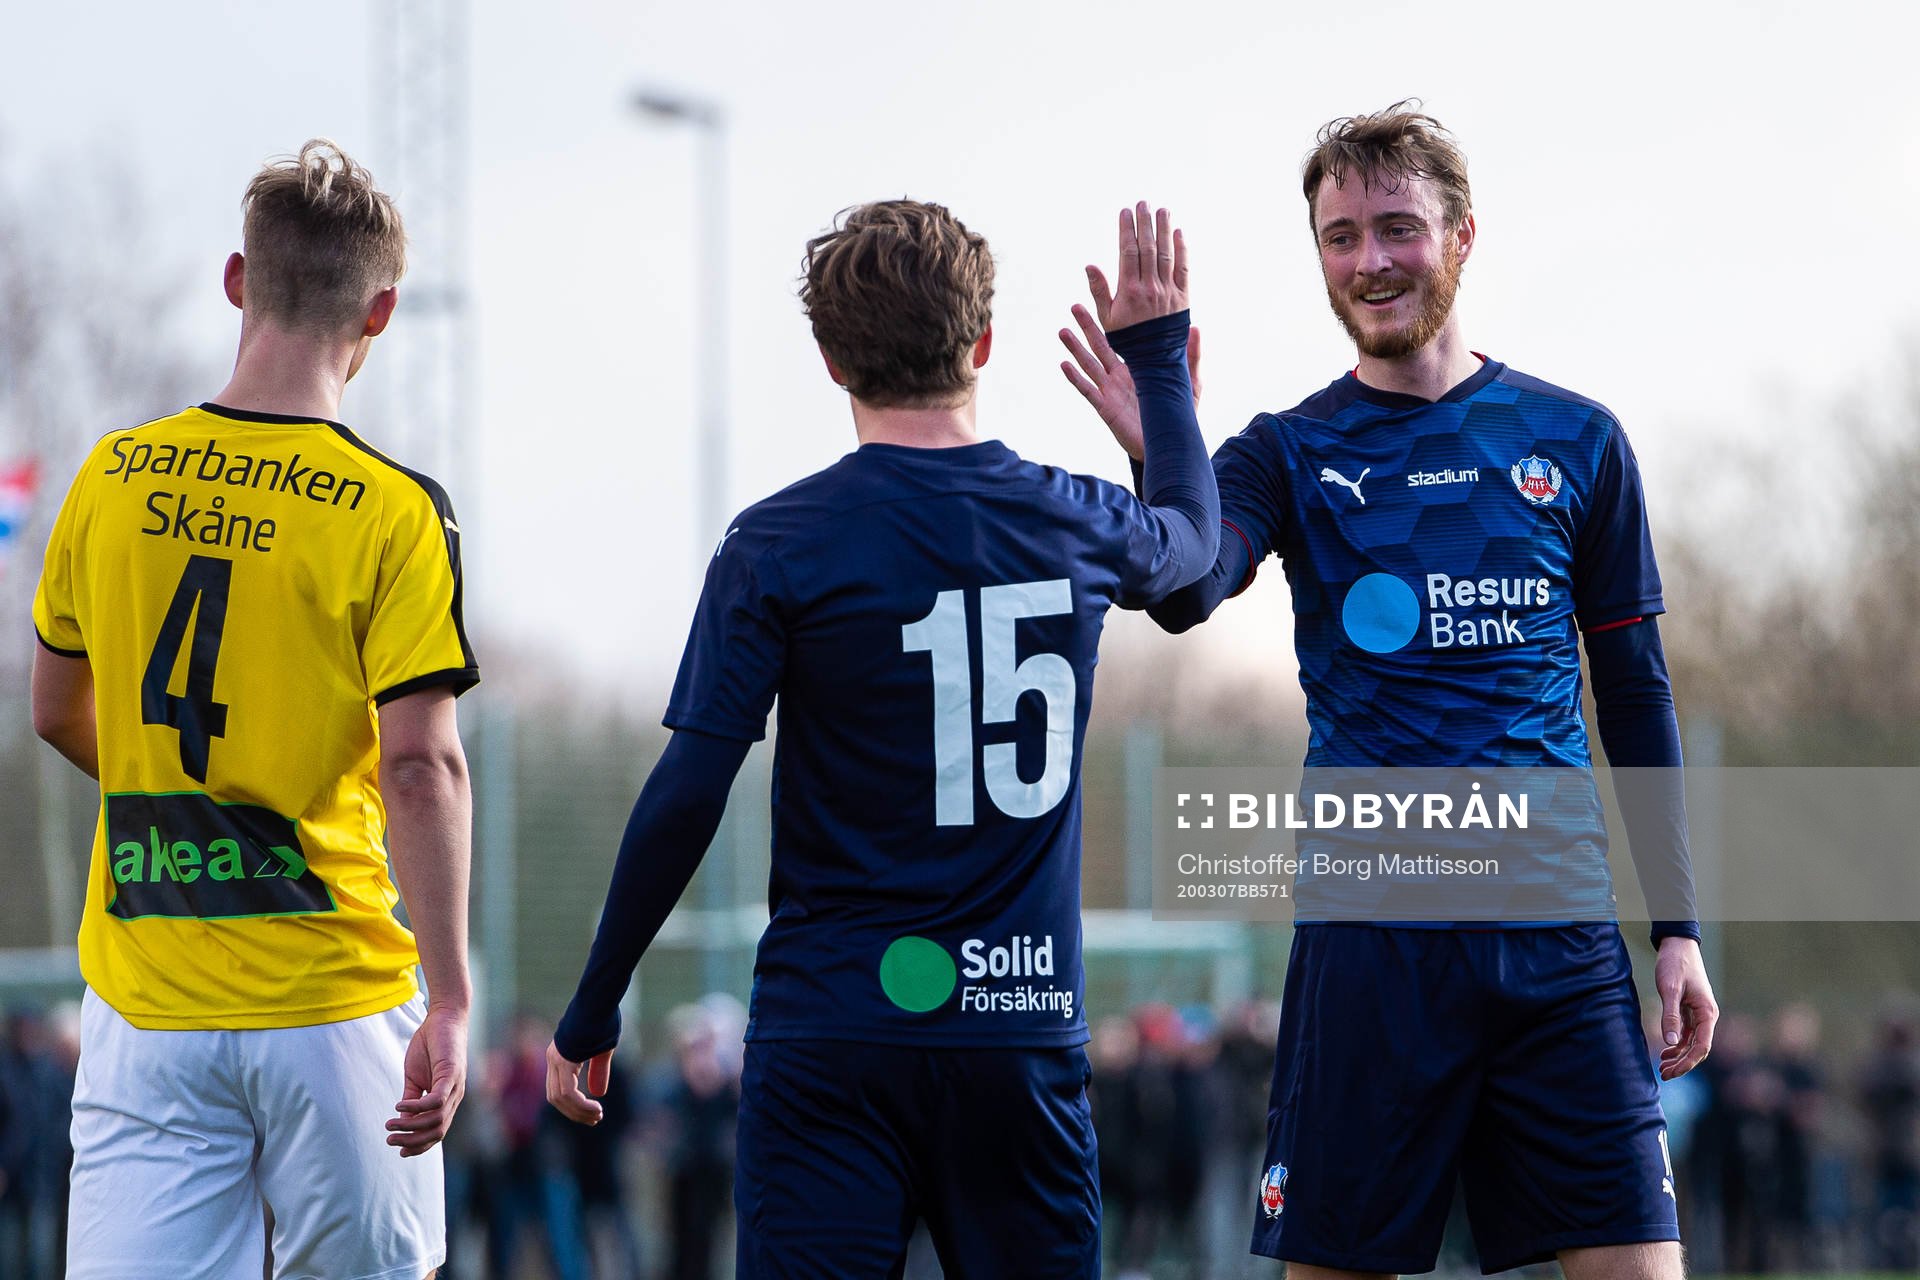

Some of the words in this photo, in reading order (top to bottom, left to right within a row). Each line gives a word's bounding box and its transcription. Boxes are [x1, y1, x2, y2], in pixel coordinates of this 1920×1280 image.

[104, 437, 366, 511] Sparbanken
[1407, 467, 1479, 487] stadium
[141, 491, 276, 553] Skåne
[1426, 573, 1550, 609] Resurs
[1430, 610, 1526, 648] Bank
[140, 554, 233, 785] 4
[901, 578, 1076, 827] 15
[113, 826, 244, 884] akea
[961, 935, 1054, 978] Solid
[961, 985, 1073, 1018] Försäkring
